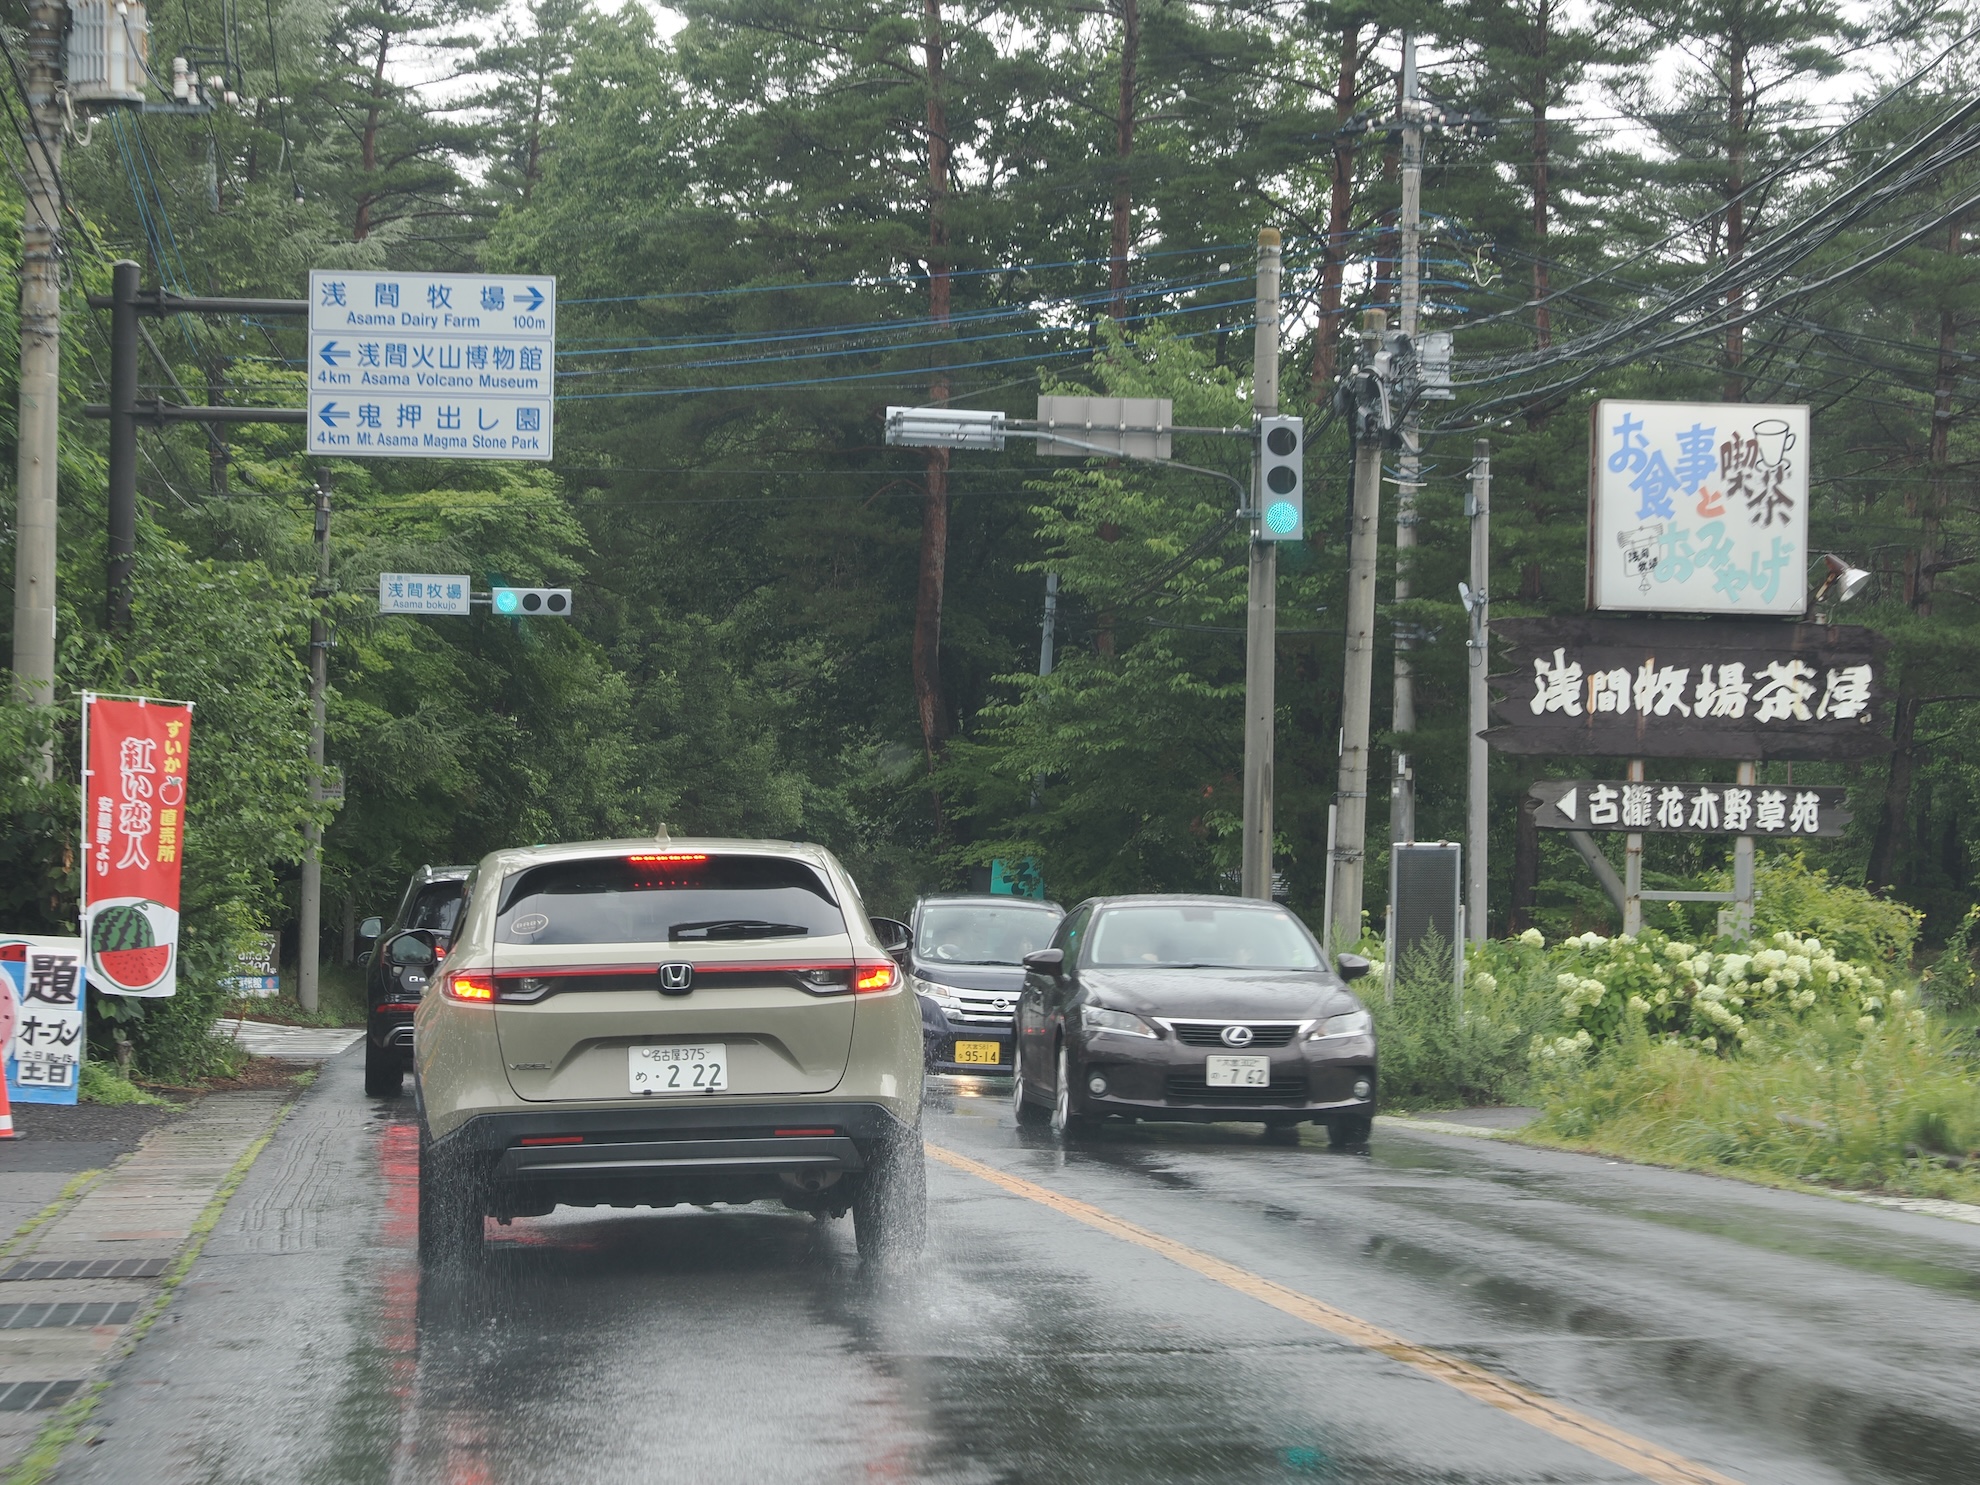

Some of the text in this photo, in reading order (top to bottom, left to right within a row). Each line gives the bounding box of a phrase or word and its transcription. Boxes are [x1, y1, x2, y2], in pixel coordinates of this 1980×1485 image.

[321, 281, 505, 311] 浅間牧場
[347, 311, 480, 329] Asama Dairy Farm
[512, 316, 546, 330] 100m
[357, 342, 543, 371] 浅間火山博物館
[361, 371, 538, 389] Asama Volcano Museum
[356, 403, 540, 431] 鬼押出し園
[357, 432, 539, 450] Mt. Asama Magma Stone Park
[1607, 412, 1794, 530] お食事 と 喫茶
[1653, 520, 1796, 604] おみやげ
[388, 582, 462, 600] 浅間牧場
[393, 600, 457, 610] Asama bokujo
[1529, 647, 1873, 724] 浅間牧場茶屋
[164, 720, 184, 774] すいか
[156, 808, 178, 863] 直売所
[24, 954, 78, 1005] 題
[19, 1015, 81, 1046] オープン
[965, 1050, 996, 1063] 95-14
[635, 1071, 648, 1083] め
